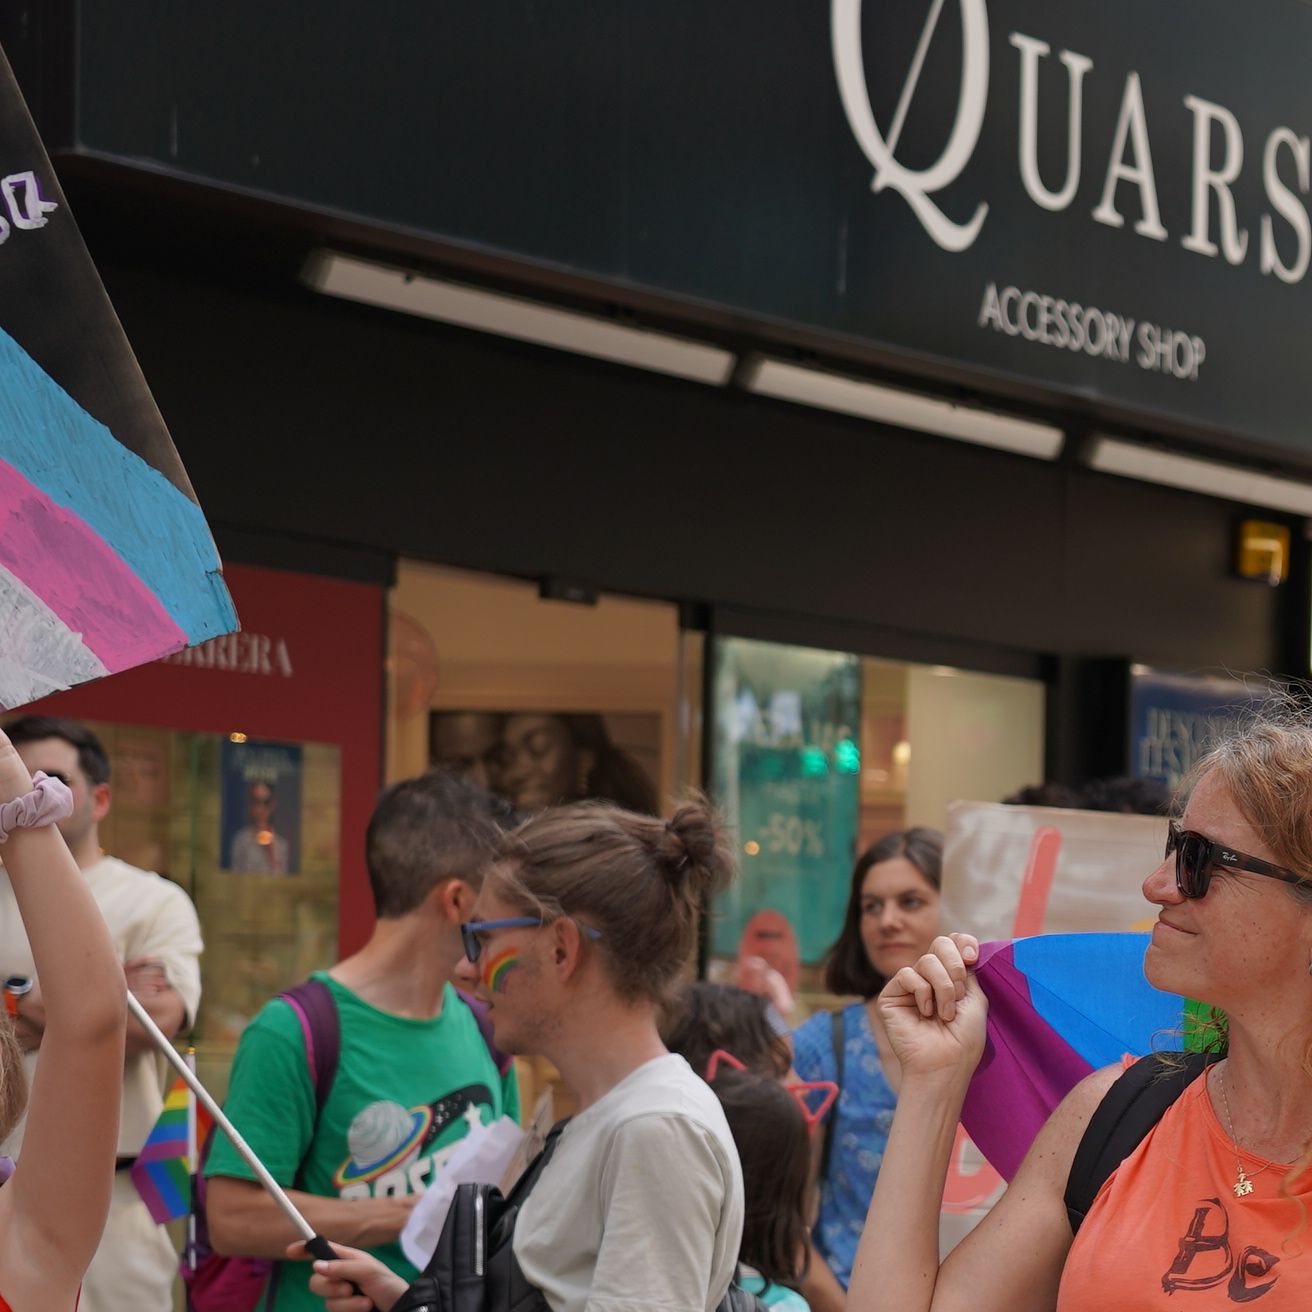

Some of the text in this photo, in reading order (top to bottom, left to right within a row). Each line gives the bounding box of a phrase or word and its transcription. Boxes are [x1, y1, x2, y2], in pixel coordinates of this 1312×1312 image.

[830, 0, 1312, 284] QUARS
[977, 280, 1207, 381] ACCESSORY SHOP
[1161, 1197, 1281, 1303] Be
